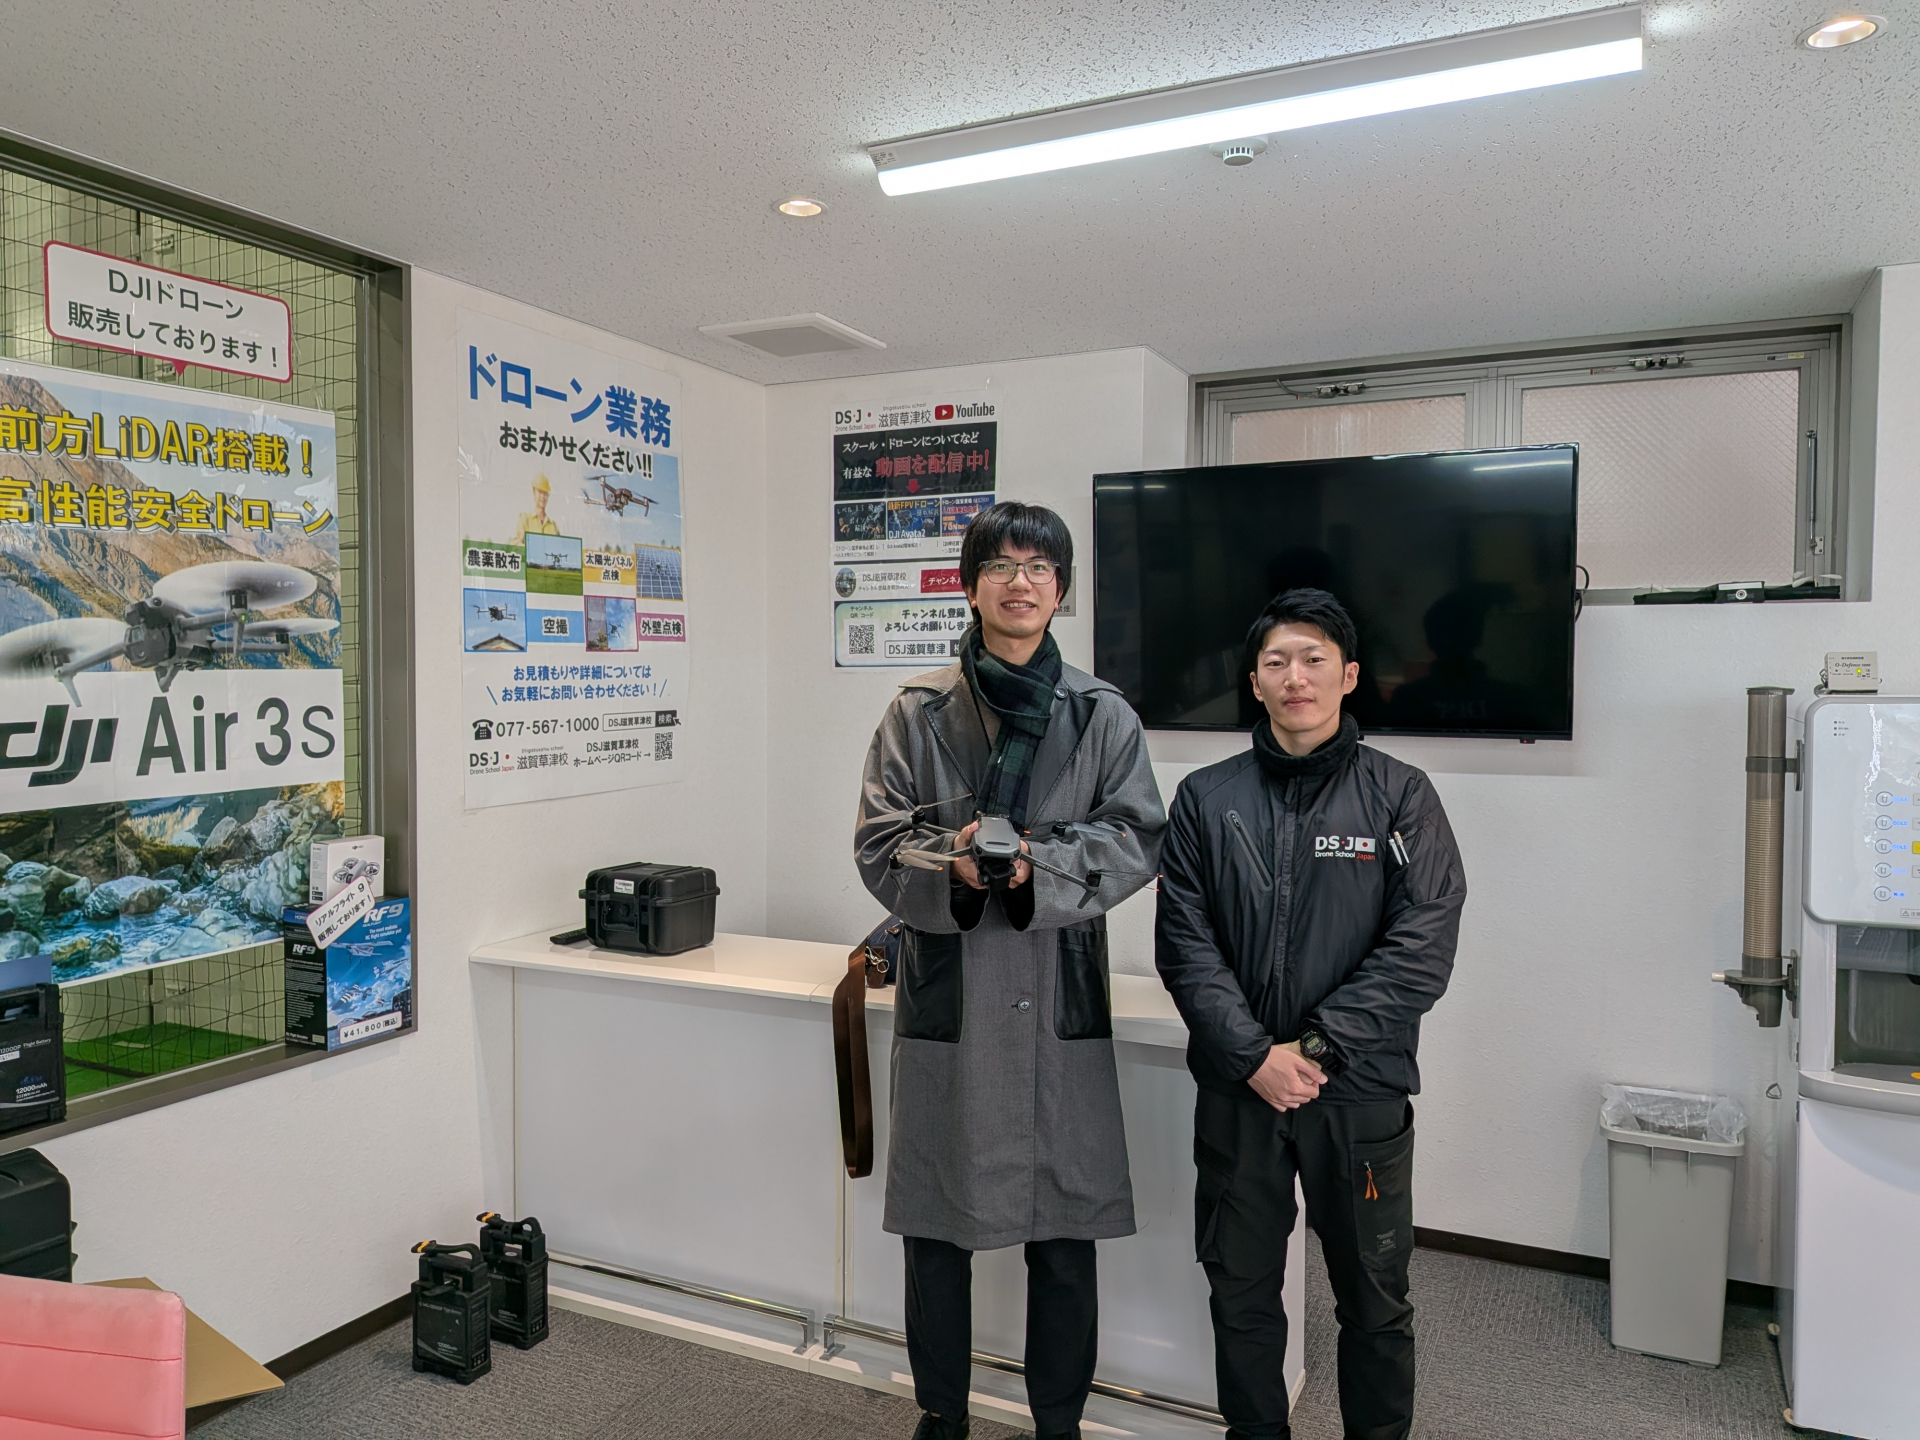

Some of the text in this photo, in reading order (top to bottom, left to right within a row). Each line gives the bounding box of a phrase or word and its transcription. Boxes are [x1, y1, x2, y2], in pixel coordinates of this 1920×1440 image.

[108, 268, 244, 320] DJIドローン
[68, 300, 279, 368] 販売しております！
[469, 345, 671, 449] ドローン業務
[956, 402, 995, 418] YouTube
[878, 410, 931, 428] 滋賀草津校
[0, 404, 313, 478] 前方LiDAR搭載！
[842, 431, 980, 454] スクール・ドローンについてなど
[843, 466, 873, 480] 有益な
[0, 477, 334, 537] 高性能安全ドローン
[888, 499, 941, 511] 最新FPVドローン
[889, 530, 900, 539] DJI
[901, 528, 926, 539] Avata2
[468, 549, 521, 571] 農薬散布
[585, 553, 633, 569] 太陽光パネル
[602, 569, 620, 582] 点検
[902, 607, 966, 620] チャンネル登録
[543, 618, 569, 635] 空撮
[642, 620, 683, 636] 外壁点検
[885, 621, 973, 633] よろしくお願いします
[889, 643, 946, 655] DSJ滋賀草津
[514, 665, 652, 682] お見積もりや詳細については
[502, 683, 657, 703] お気軽にお問い合わせください！
[496, 717, 600, 738] 077-567-1000
[608, 716, 653, 728] DSJ滋賀草津校
[136, 695, 239, 777] Air
[587, 739, 640, 753] DSJ滋賀草津校
[517, 753, 569, 771] 滋賀草津校
[573, 751, 642, 768] ホームページQRコード
[470, 765, 515, 776] Drone School Japan
[1335, 851, 1356, 859] School
[1356, 853, 1376, 861] Japan
[315, 893, 356, 927] リアルフライト
[363, 903, 405, 924] RF9
[318, 895, 372, 943] 販売しております！
[292, 944, 317, 955] RF9
